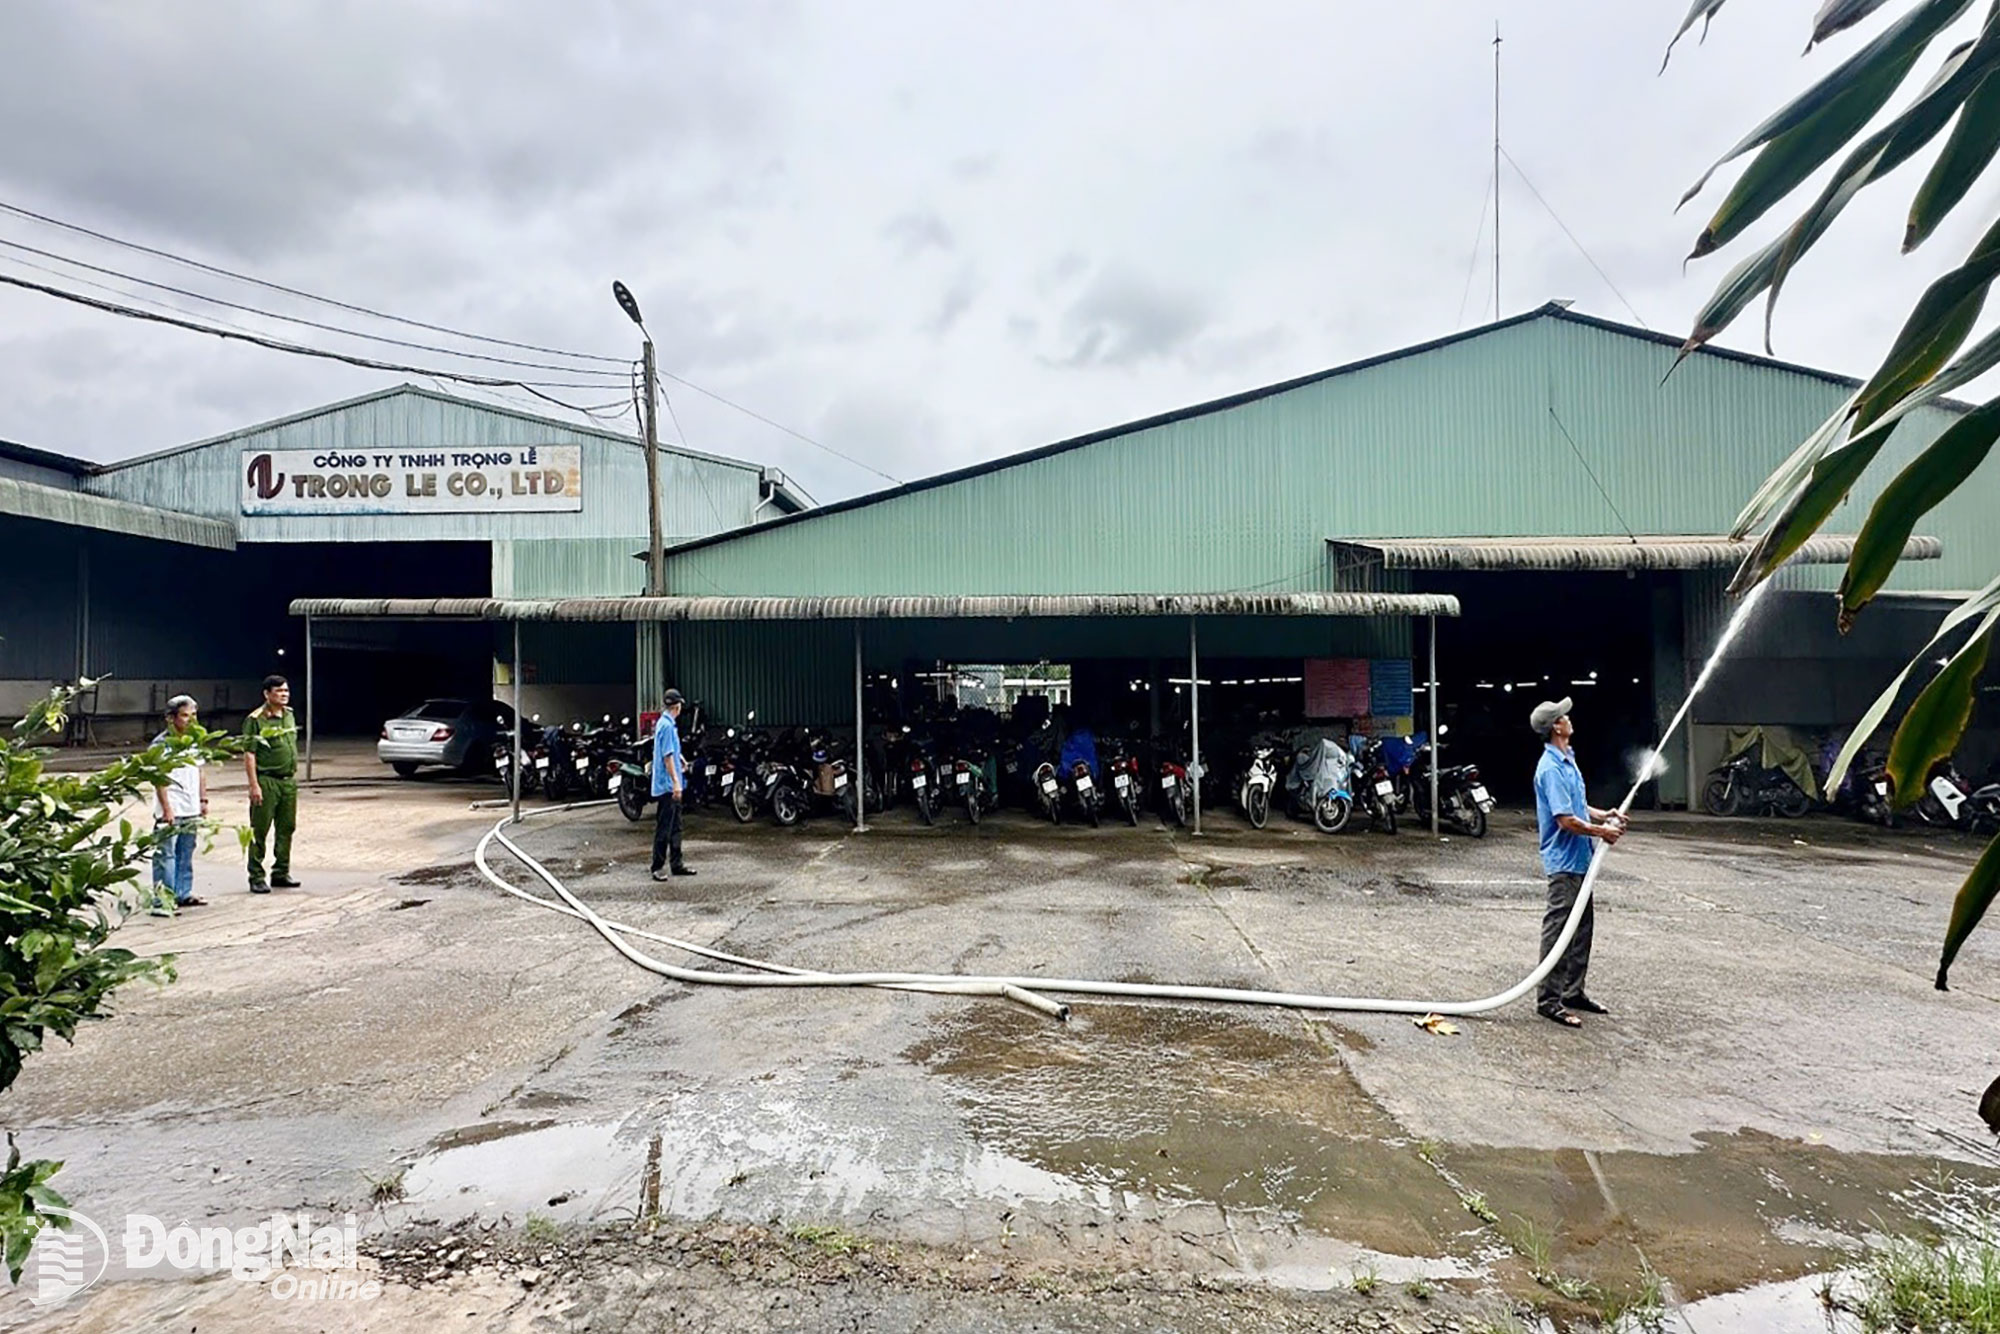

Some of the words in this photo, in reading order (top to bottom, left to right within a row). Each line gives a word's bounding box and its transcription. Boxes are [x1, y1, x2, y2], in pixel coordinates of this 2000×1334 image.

[313, 451, 367, 468] CÔNG
[373, 455, 393, 468] TY
[399, 453, 445, 468] TNHH
[451, 452, 513, 469] TRỌNG
[291, 473, 392, 498] TRONG
[405, 472, 437, 497] LE
[446, 471, 503, 499] CO.,
[511, 470, 564, 496] LTD
